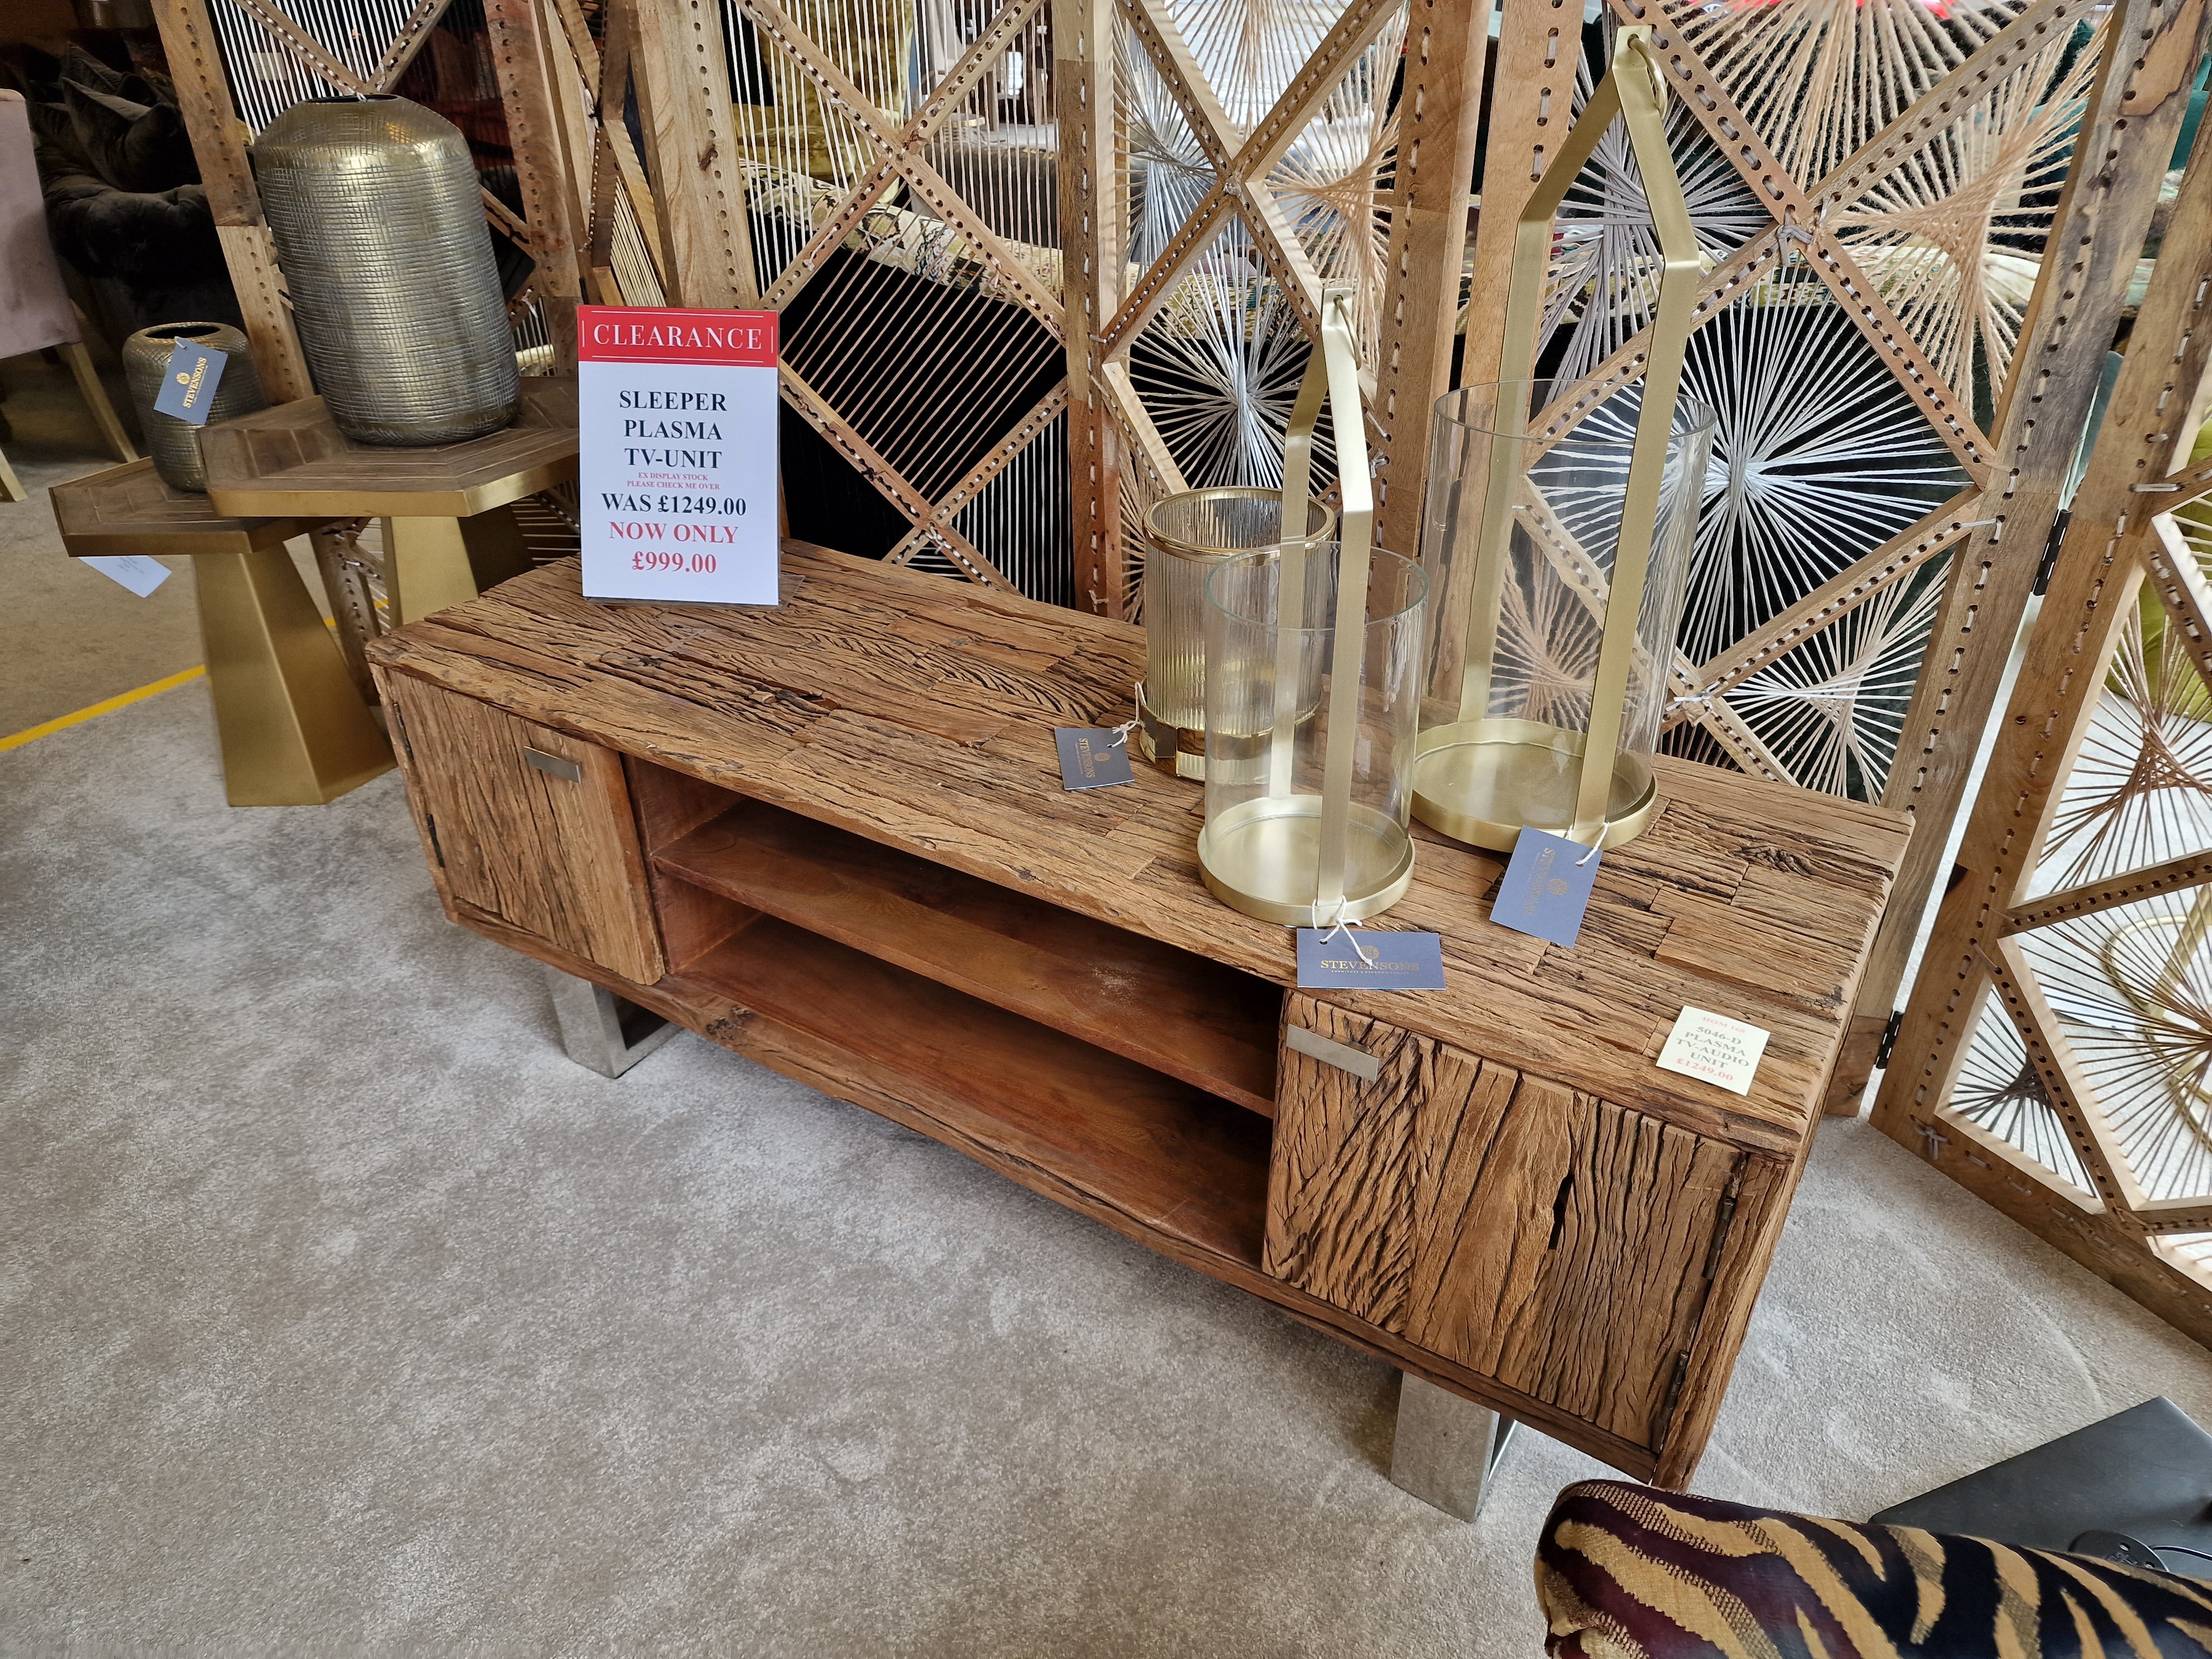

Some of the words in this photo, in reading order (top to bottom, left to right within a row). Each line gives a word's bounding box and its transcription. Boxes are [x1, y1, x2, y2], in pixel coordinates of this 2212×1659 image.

[593, 324, 763, 350] CLEARANCE
[182, 357, 207, 408] STEVENSONS
[619, 390, 728, 411] SLEEPER
[624, 419, 723, 440] PLASMA
[624, 448, 722, 469] TV-UNIT
[601, 493, 651, 512] WAS
[658, 495, 747, 516] £1249.00
[609, 521, 666, 540] NOW
[674, 524, 739, 544] ONLY
[632, 551, 717, 573] £999.00
[1079, 738, 1095, 778] STEVENSONS
[1321, 960, 1420, 971] STEVENSONS
[1685, 1032, 1746, 1057] PLASMA
[1696, 1026, 1742, 1045] 5046-D
[1676, 1038, 1750, 1067] TV-AUDIO
[1691, 1052, 1728, 1068] UNIT
[1676, 1058, 1734, 1081] £1249.00
